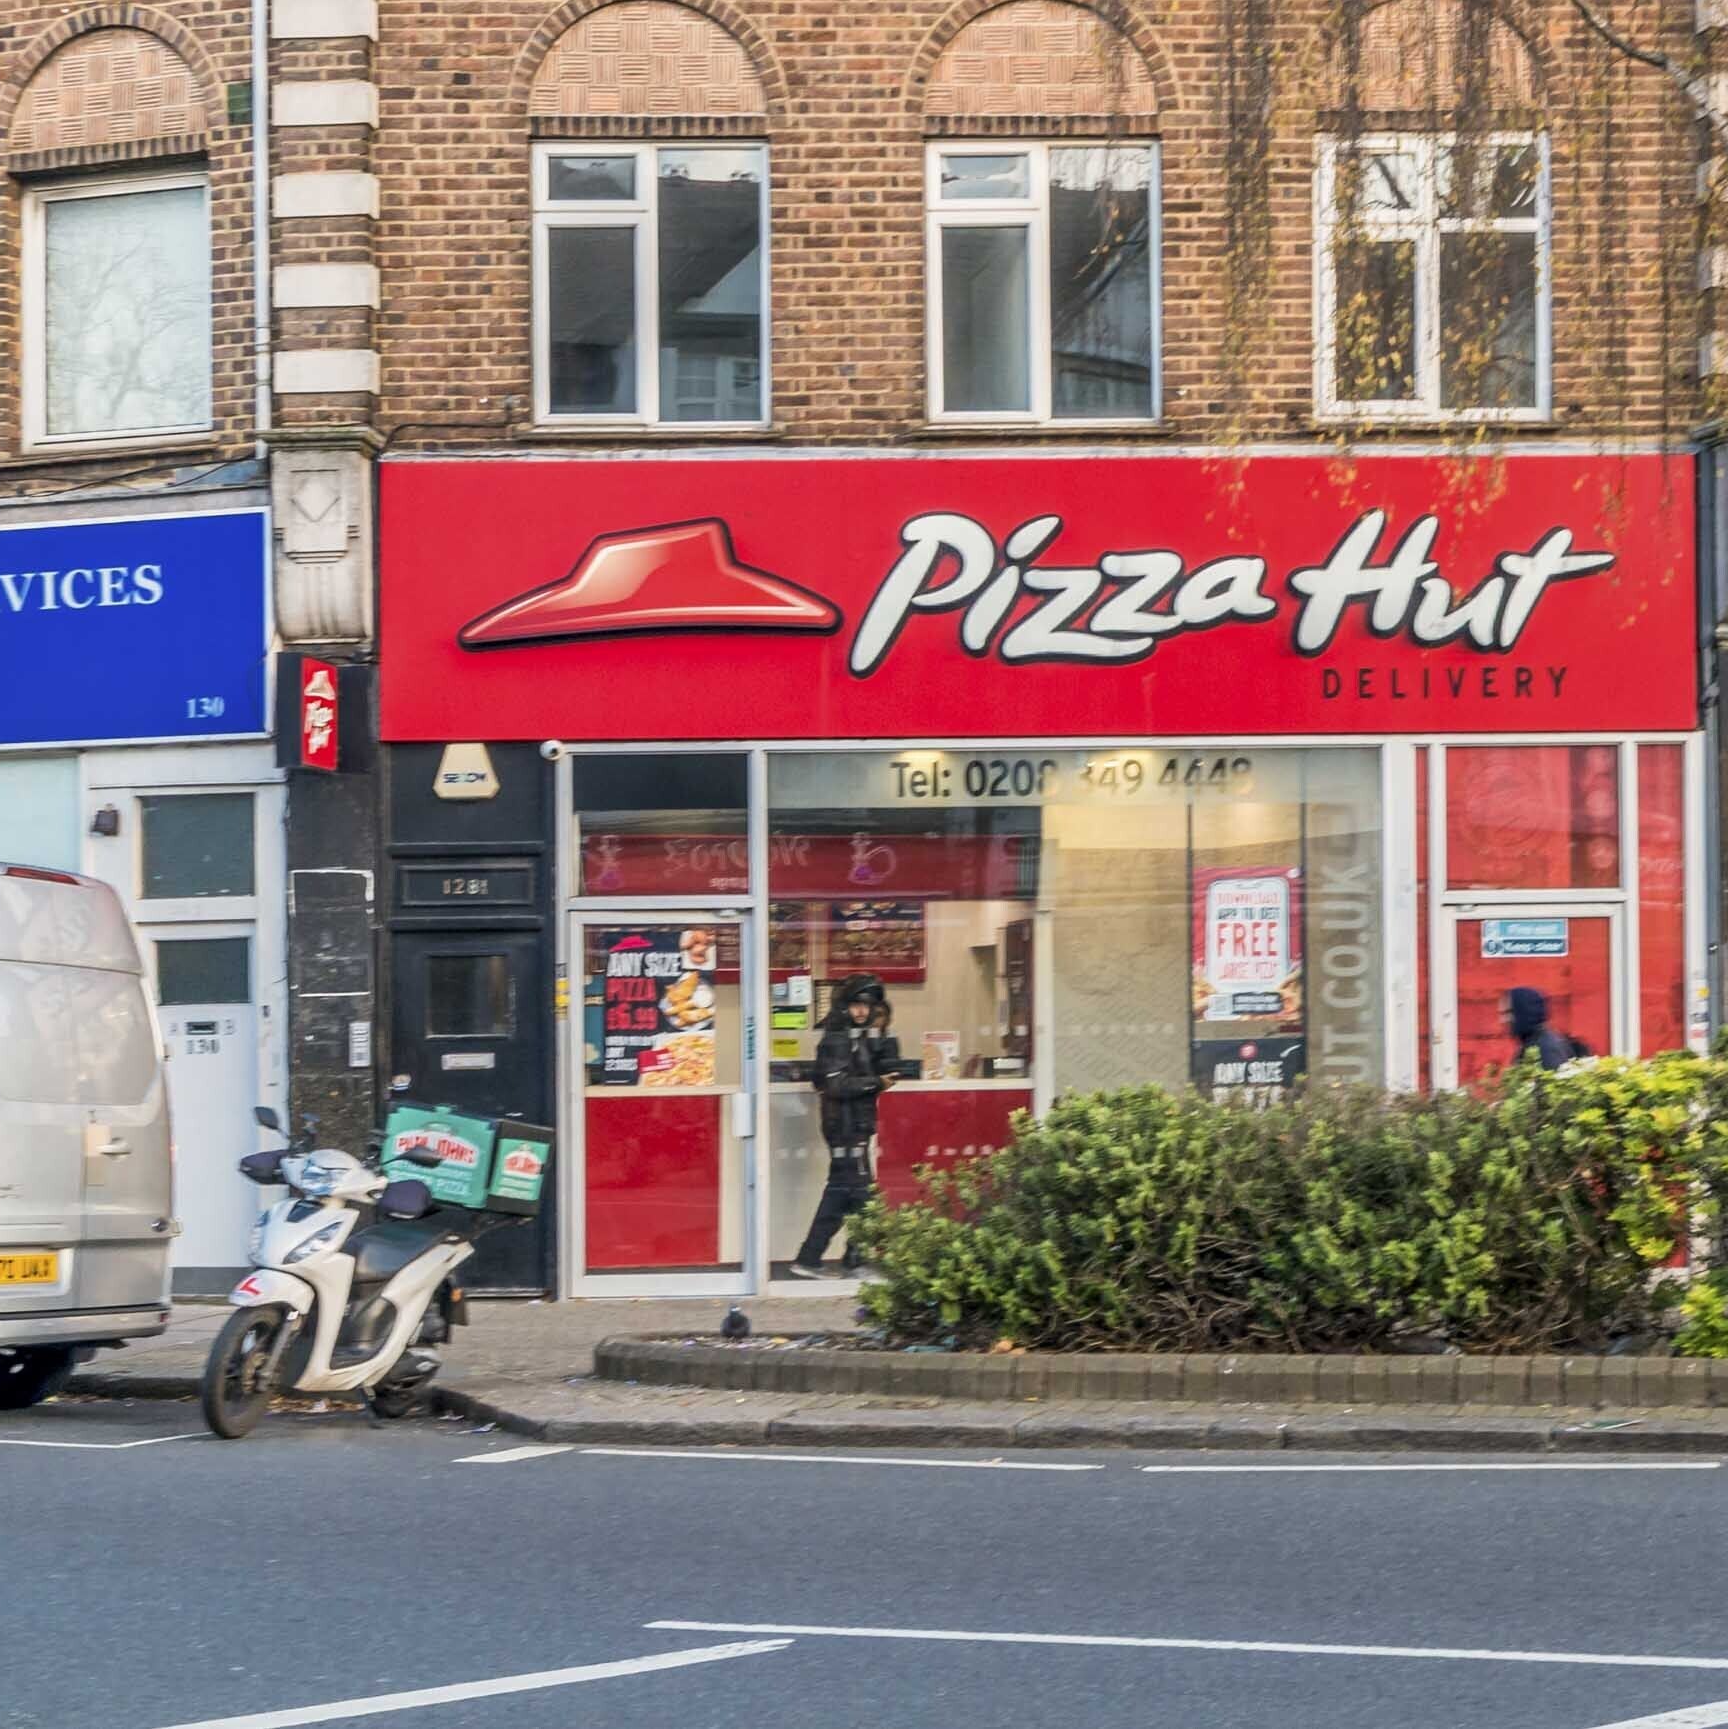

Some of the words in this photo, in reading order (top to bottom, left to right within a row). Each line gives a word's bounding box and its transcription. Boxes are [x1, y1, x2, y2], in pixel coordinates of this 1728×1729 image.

[849, 510, 1276, 678] Pizza
[1288, 507, 1616, 658] Hut
[1320, 667, 1570, 701] DELIVERY
[186, 697, 226, 720] 130
[890, 761, 952, 799] Tel:
[1217, 921, 1278, 958] FREE
[606, 952, 644, 977] ANY
[643, 951, 682, 977] SIZE
[1214, 1061, 1247, 1086] ANY
[1247, 1060, 1284, 1083] SIZE
